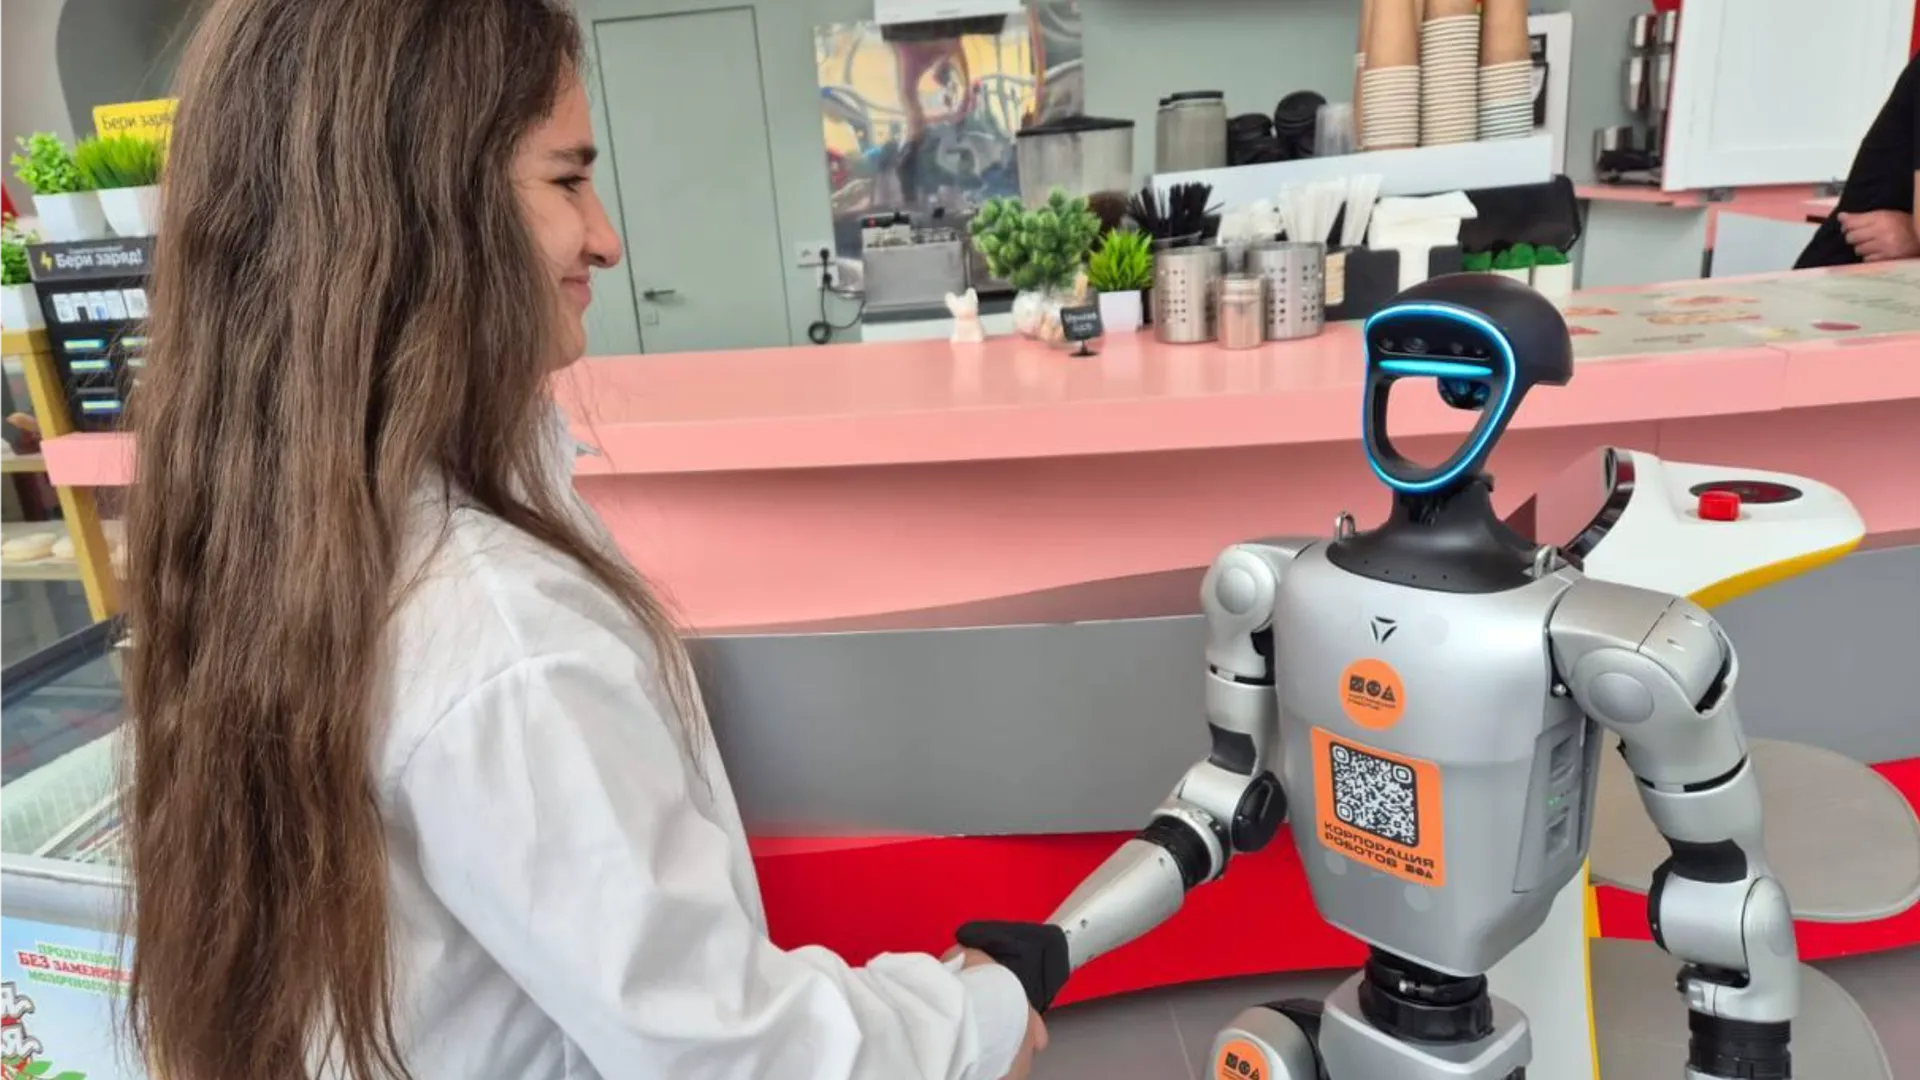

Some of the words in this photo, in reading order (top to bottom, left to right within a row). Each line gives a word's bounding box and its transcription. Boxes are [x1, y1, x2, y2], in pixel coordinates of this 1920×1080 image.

[55, 252, 94, 270] Бери
[95, 247, 143, 267] заряд!
[1324, 820, 1435, 869] КОРПОРАЦИЯ
[1325, 832, 1398, 868] РОБОТОВ
[18, 951, 50, 969] БЕЗ
